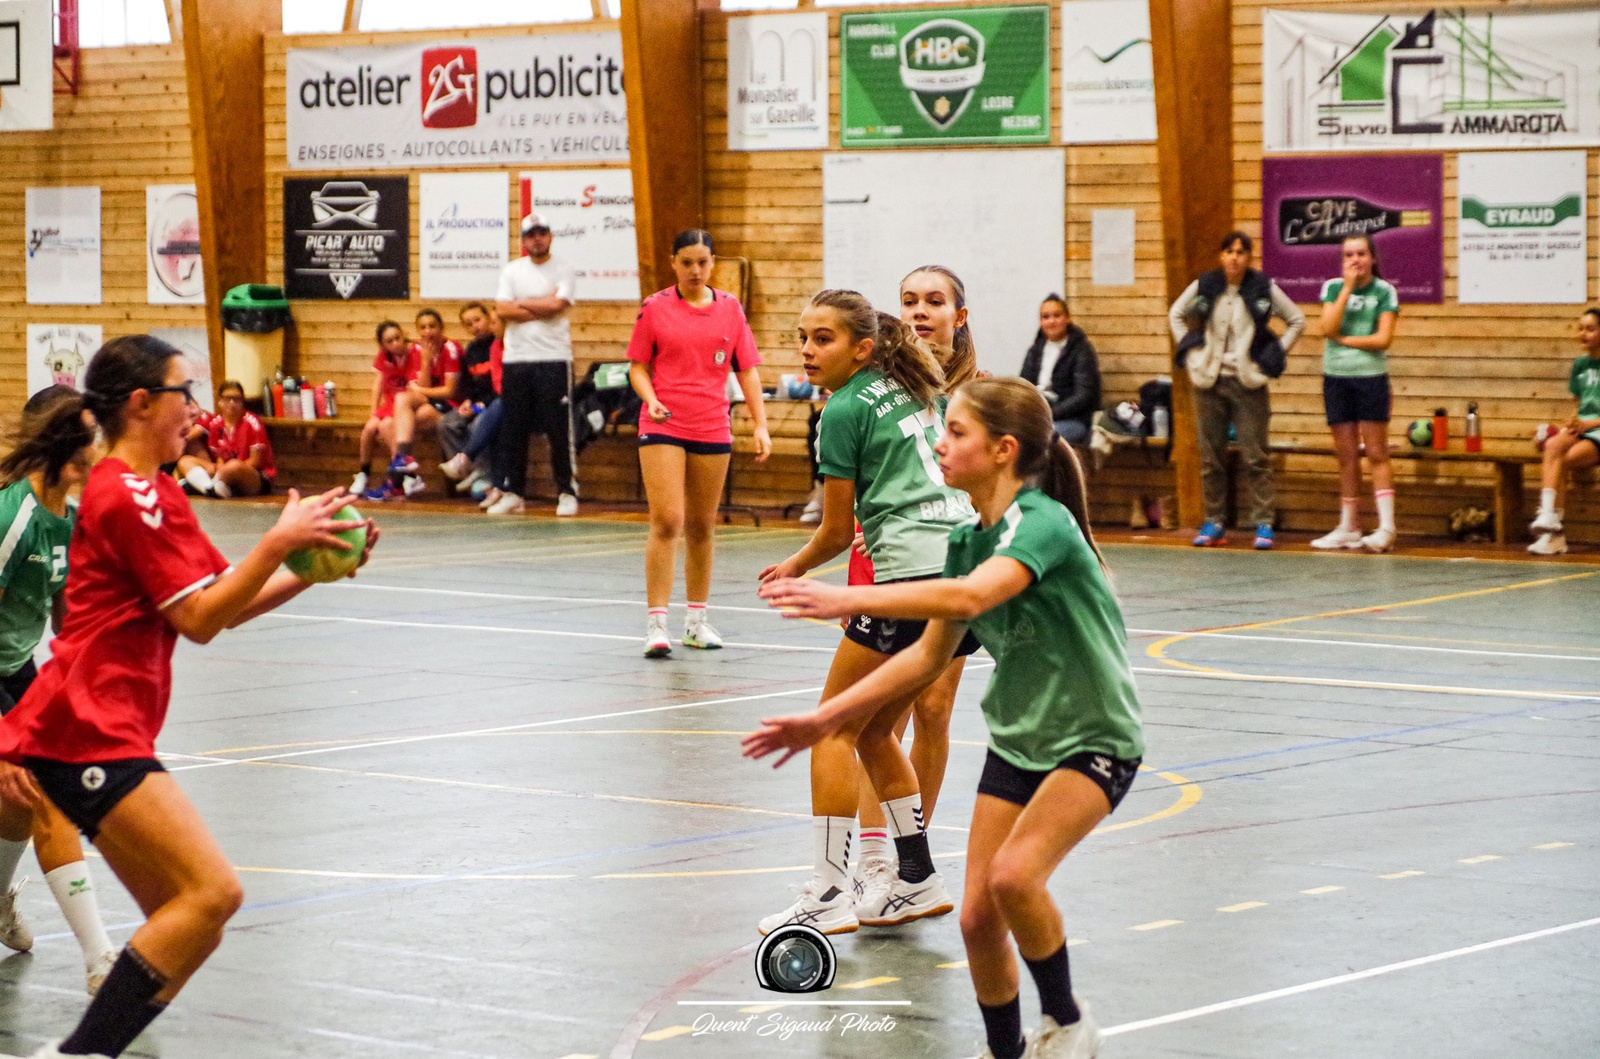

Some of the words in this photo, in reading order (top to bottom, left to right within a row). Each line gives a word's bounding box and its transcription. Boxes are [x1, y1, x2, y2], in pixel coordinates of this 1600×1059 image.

[915, 36, 970, 65] HBC
[300, 65, 411, 108] atelier
[298, 144, 385, 161] ENSEIGNES
[403, 135, 533, 157] AUTOCOLLANTS
[437, 218, 504, 228] PRODUCTION
[1486, 208, 1556, 224] EYRAUD
[349, 235, 385, 251] AUTO
[876, 402, 894, 418] BAR
